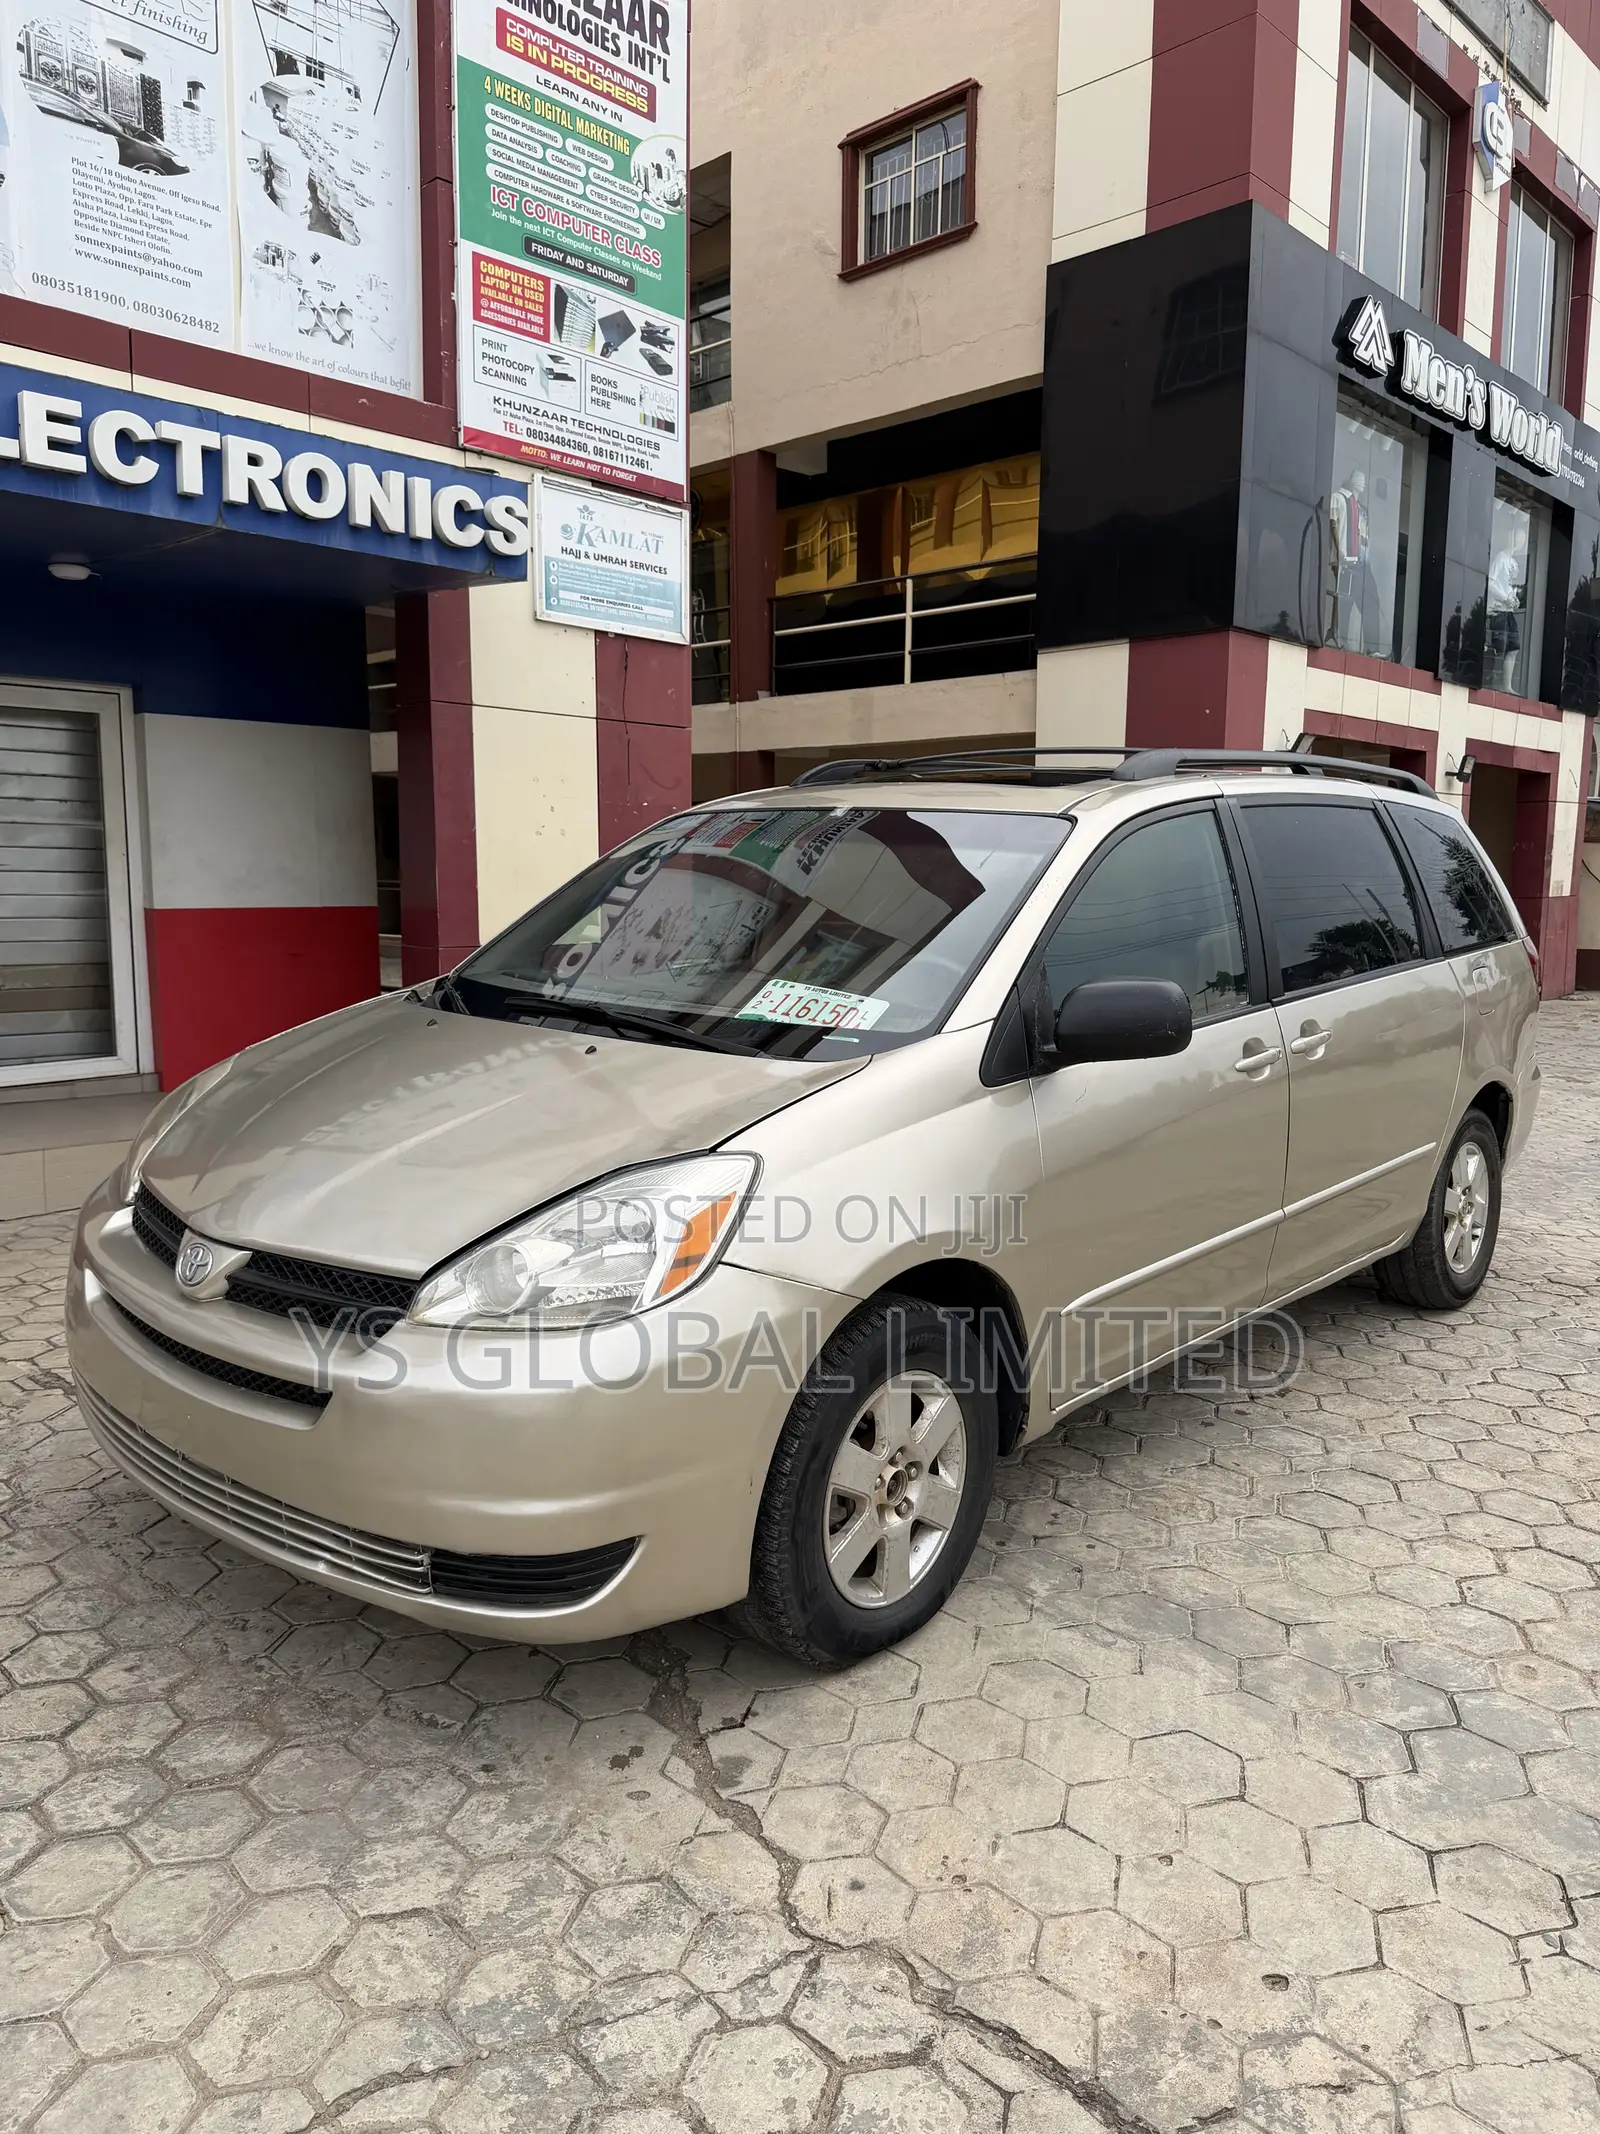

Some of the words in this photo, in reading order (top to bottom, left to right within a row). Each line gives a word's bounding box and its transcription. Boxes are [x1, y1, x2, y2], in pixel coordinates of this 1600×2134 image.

[129, 1, 208, 45] finishing
[506, 18, 585, 67] COMPUTER
[587, 57, 649, 96] TRAINING
[506, 32, 524, 54] IS
[527, 41, 548, 64] IN
[551, 55, 649, 113] PROGRESS
[628, 39, 671, 84] INT'L
[484, 75, 491, 95] 4
[493, 81, 532, 112] WEEKS
[534, 98, 574, 131] DIGITAL
[576, 115, 630, 157] MARKETING
[536, 75, 580, 102] LEARN
[581, 96, 610, 115] ANY
[610, 109, 623, 123] IN
[490, 108, 521, 128] DESKTOP
[521, 121, 559, 144] PUBLISHING
[491, 128, 508, 142] DATA
[508, 135, 538, 154] ANALYSIS
[492, 149, 515, 164] SOCIAL
[516, 157, 536, 172] MEDIA
[537, 165, 579, 190] MANAGEMENT
[550, 153, 582, 172] COACHING
[572, 143, 587, 156] WEB
[587, 150, 609, 166] DESIGN
[71, 156, 87, 167] Plot
[89, 162, 113, 176] 16/18
[115, 171, 137, 185] Ojobo
[138, 178, 168, 195] Avenue,
[168, 189, 181, 199] Off
[181, 193, 200, 207] Igesu
[72, 167, 106, 184] Olayemi,
[107, 178, 133, 193] Ayobo,
[134, 187, 158, 201] Lagos.
[592, 172, 617, 190] GRAPHIC
[618, 182, 639, 198] DESIGN
[72, 178, 93, 190] Lotto
[94, 185, 118, 199] Plaza,
[118, 192, 137, 206] Opp.
[137, 198, 155, 210] Fara
[155, 204, 173, 216] Park
[174, 210, 199, 225] Estate,
[199, 218, 213, 229] Epe
[72, 188, 103, 205] Express
[104, 196, 126, 212] Road,
[127, 205, 151, 220] Lekki,
[152, 212, 175, 227] Lagos.
[494, 169, 530, 190] COMPUTER
[530, 182, 565, 203] HARDWARE
[565, 197, 571, 205] &
[571, 199, 603, 218] SOFTWARE
[603, 212, 641, 235] ENGINEERING
[589, 189, 608, 204] CYBER
[609, 197, 636, 214] SECURITY
[72, 198, 95, 211] Aisha
[96, 205, 119, 220] Plaza,
[120, 213, 138, 224] Lasu
[139, 218, 168, 234] Express
[169, 228, 190, 242] Road,
[73, 209, 108, 226] Opposite
[110, 220, 144, 237] Diamond
[145, 231, 171, 245] Estate,
[74, 219, 100, 233] Beside
[101, 227, 123, 240] NNPC
[124, 234, 147, 248] Isheri
[148, 241, 173, 255] Olofin.
[491, 186, 517, 211] ICT
[522, 199, 611, 247] COMPUTER
[615, 236, 662, 267] CLASS
[74, 232, 203, 278] sonnexpaints@yahoo.com
[491, 208, 508, 221] Join
[509, 214, 523, 227] the
[524, 221, 541, 233] next
[542, 226, 555, 238] ICT
[557, 232, 592, 254] Computer
[593, 246, 620, 264] Classes
[622, 258, 631, 268] on
[632, 261, 662, 281] Weekend
[75, 248, 192, 289] www.sonnexpaints.com
[480, 260, 544, 292] COMPUTERS
[531, 243, 565, 267] FRIDAY
[566, 254, 585, 270] AND
[586, 263, 629, 287] SATURDAY
[31, 272, 130, 310] 08035181900,
[133, 300, 220, 334] 08030628482
[480, 274, 510, 292] LAPTOP
[511, 285, 523, 297] UK
[524, 289, 545, 303] USED
[480, 286, 513, 305] AVAILABLE
[514, 297, 524, 307] ON
[524, 300, 544, 314] SALES
[480, 299, 489, 308] @
[490, 301, 526, 321] AFFORDABLE
[527, 312, 544, 325] PRICE
[480, 309, 516, 327] ACCESSORIES
[517, 319, 544, 336] AVAILABLE
[482, 338, 508, 353] PRINT
[268, 342, 294, 359] know
[295, 351, 310, 364] the
[312, 356, 325, 367] art
[327, 361, 338, 374] of
[338, 363, 369, 380] colours
[371, 371, 387, 384] that
[390, 376, 411, 391] befit!
[482, 352, 536, 376] PHOTOCOPY
[482, 366, 527, 387] SCANNING
[590, 373, 618, 389] BOOKS
[590, 386, 636, 407] PUBLISHING
[590, 396, 611, 410] HERE
[1401, 328, 1487, 430] Men's
[1489, 380, 1564, 478] World
[493, 396, 568, 425] KHUNZAAR
[571, 417, 660, 451] TECHNOLOGIES
[503, 421, 523, 436] TEL:
[526, 427, 590, 456] 08034484360,
[593, 445, 653, 471] 08167112461.
[520, 445, 548, 459] MOTTO:
[550, 452, 562, 462] WE
[563, 456, 585, 470] LEARN
[586, 462, 601, 473] NOT
[602, 466, 611, 476] TO
[612, 469, 638, 483] FORGET
[576, 521, 664, 555] KAMLAT
[561, 546, 582, 560] HAJJ
[583, 551, 591, 560] &
[593, 553, 627, 568] UMRAH
[629, 560, 668, 576] SERVICES
[606, 600, 631, 609] ENQUIRIES
[828, 991, 852, 999] LIMITED
